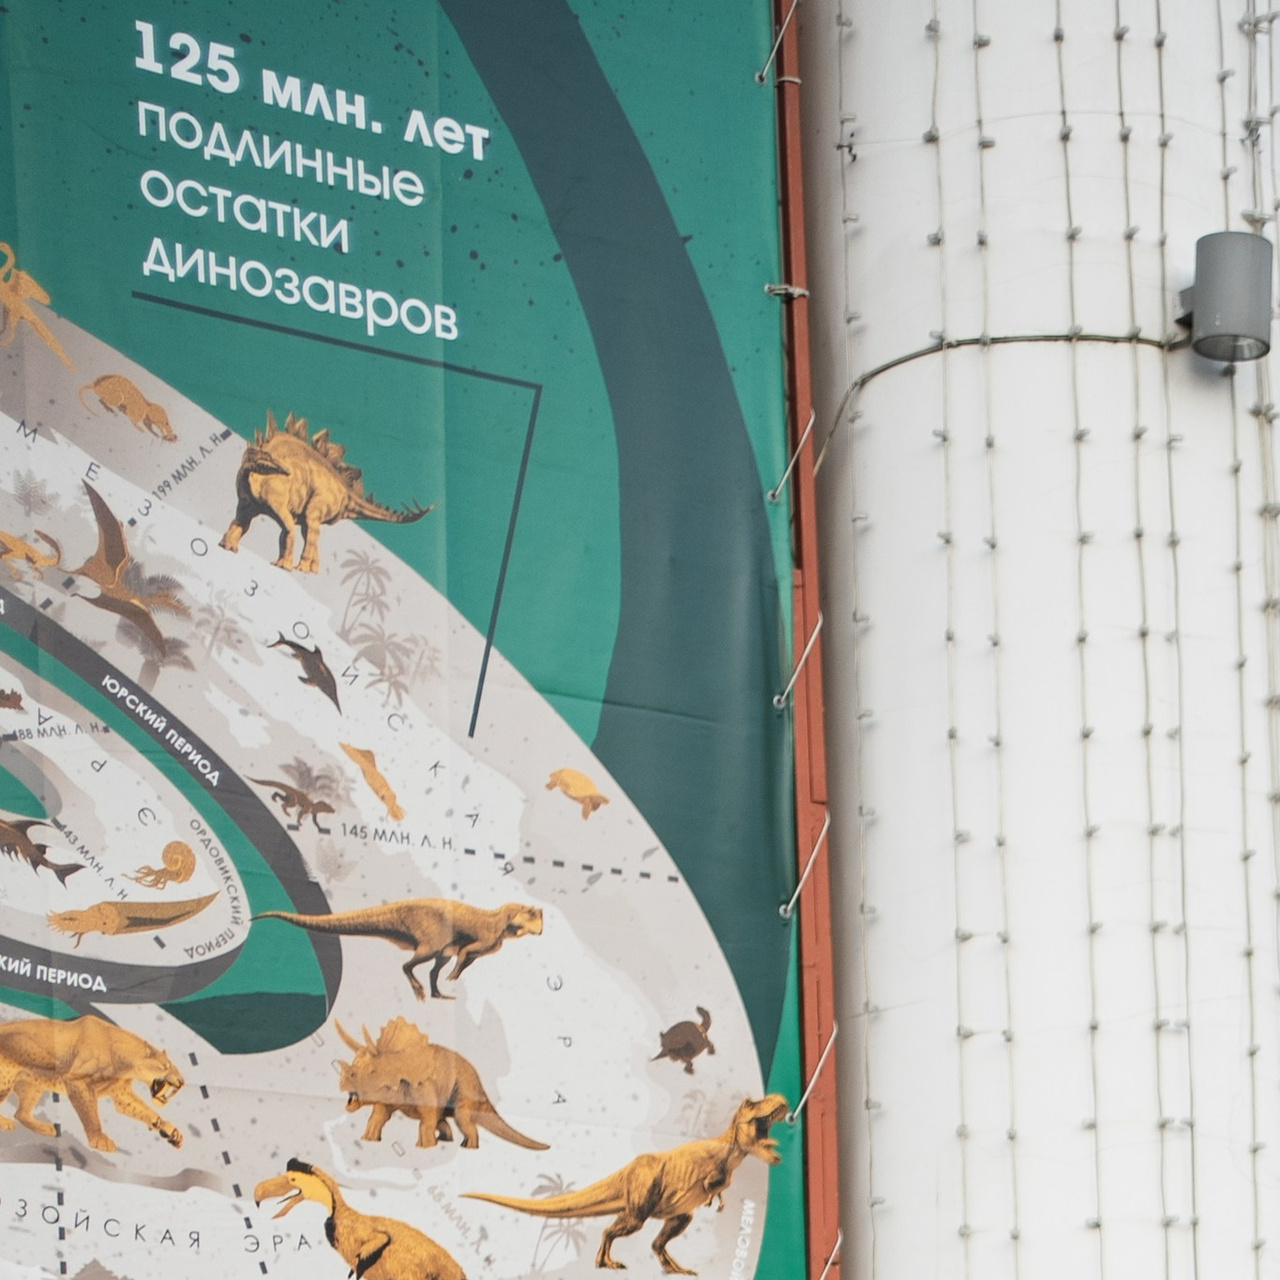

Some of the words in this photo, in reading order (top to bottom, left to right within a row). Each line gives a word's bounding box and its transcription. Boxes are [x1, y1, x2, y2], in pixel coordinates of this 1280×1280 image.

[134, 20, 240, 94] 125
[262, 68, 383, 134] млн.
[404, 110, 490, 161] лет
[138, 100, 426, 207] подлинные
[140, 169, 350, 253] остатки
[142, 236, 459, 341] динозавров
[152, 480, 173, 500] 199
[102, 674, 168, 733] ЮРСКИЙ
[165, 728, 221, 788] ПЕРИОД
[190, 818, 244, 926] ОРДОВИКСКИЙ
[341, 822, 368, 840] 145
[373, 828, 415, 846] МЛН.
[36, 963, 107, 992] ПЕРИОД
[184, 927, 236, 960] ПЕРИОД
[0, 1196, 201, 1249] ЗОЙСКАЯ
[244, 1234, 312, 1253] ЭРА
